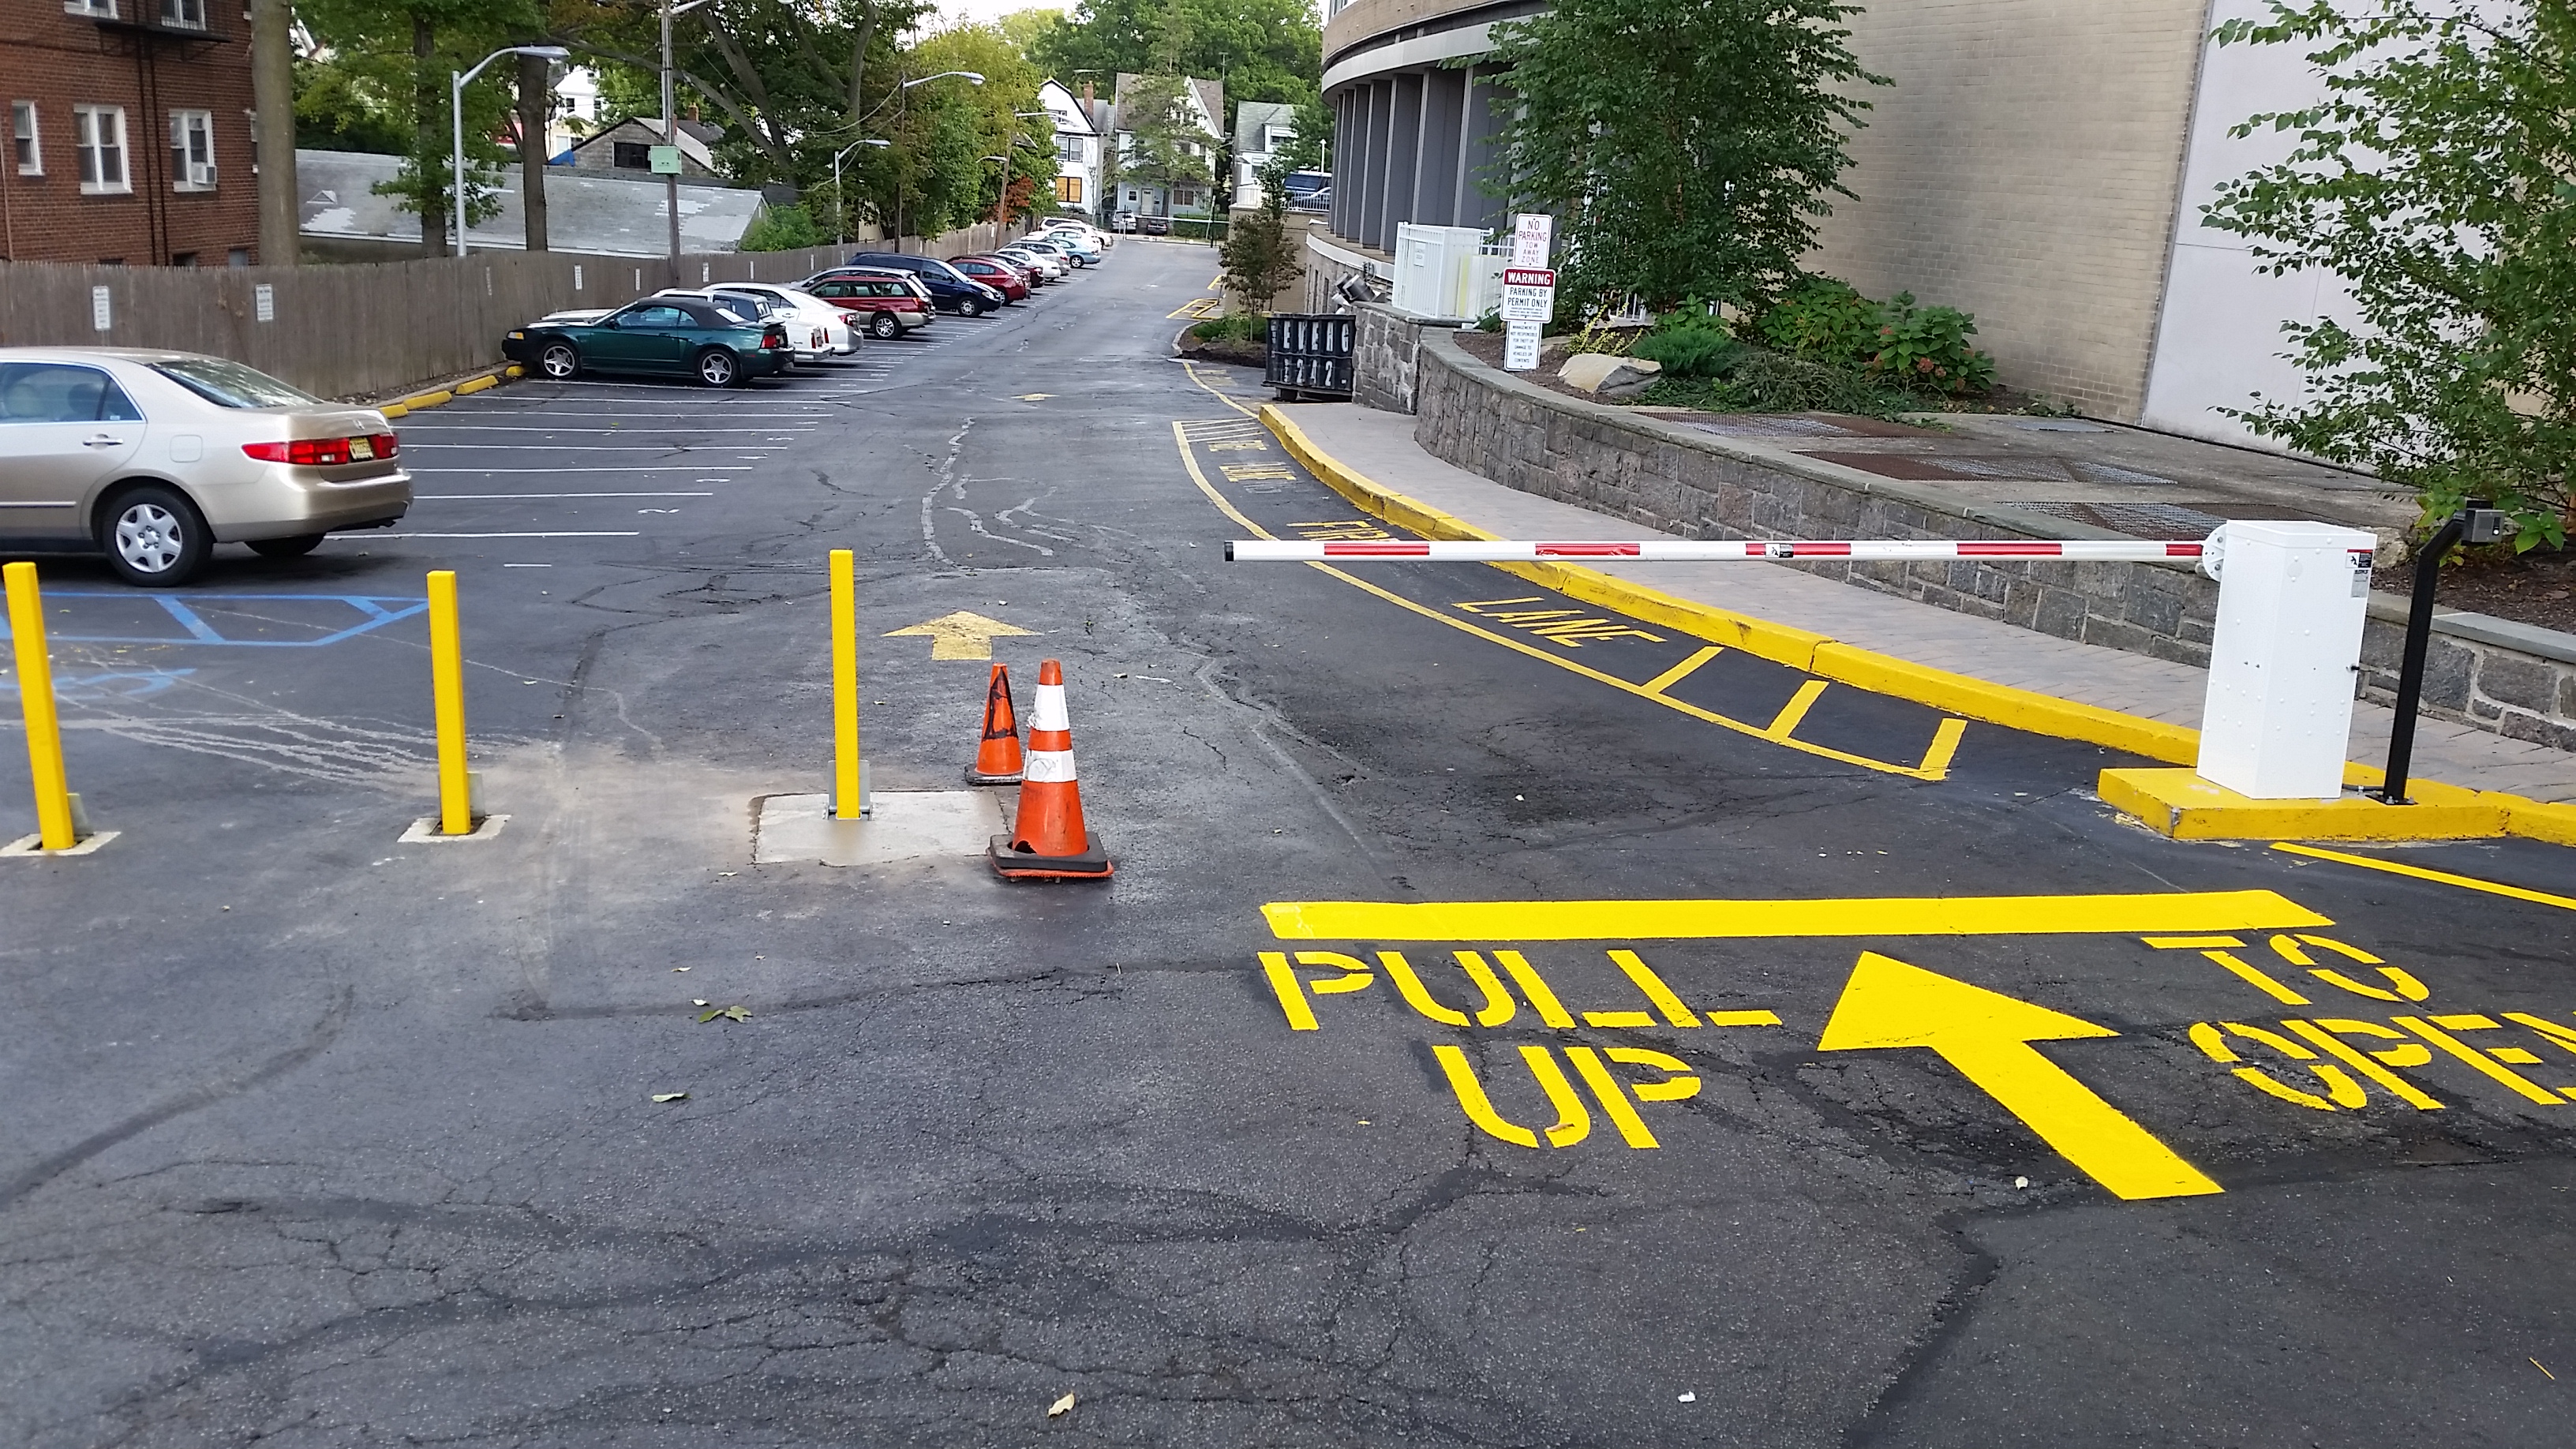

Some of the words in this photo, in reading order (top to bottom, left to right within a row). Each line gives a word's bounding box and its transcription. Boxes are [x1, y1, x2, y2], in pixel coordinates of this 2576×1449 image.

[1527, 220, 1540, 230] NO
[1518, 230, 1547, 242] PARKING
[1507, 271, 1551, 285] WARNING
[1510, 287, 1537, 297] PARKING
[1539, 288, 1548, 298] BY
[1507, 297, 1530, 307] PERMIT
[1531, 298, 1548, 308] ONLY
[1451, 597, 1668, 647] LANE
[2144, 934, 2431, 1005] TO
[1258, 949, 1783, 1031] PULL
[1432, 1043, 1703, 1151] UP
